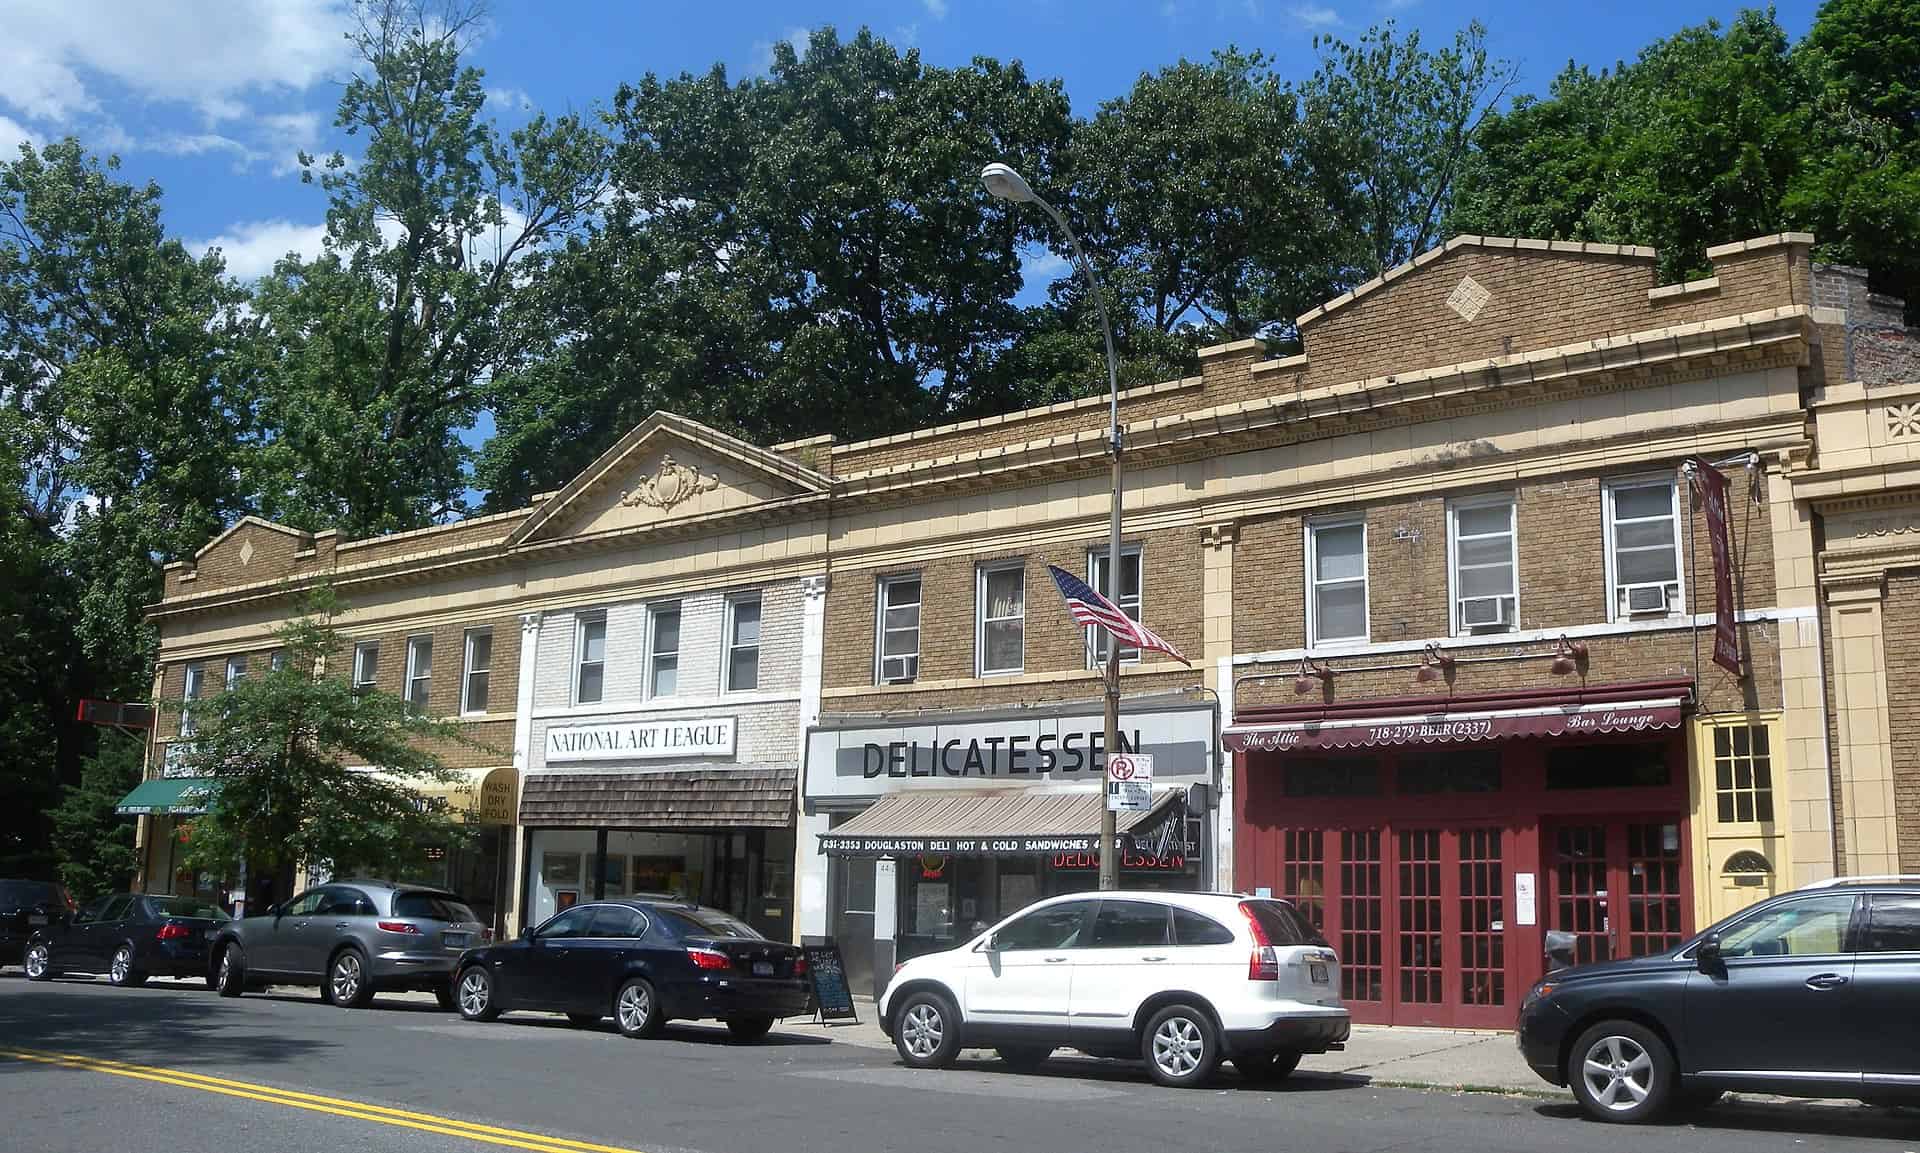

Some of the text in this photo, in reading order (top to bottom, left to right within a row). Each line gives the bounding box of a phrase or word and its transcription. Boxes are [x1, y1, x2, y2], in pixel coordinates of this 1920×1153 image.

[1567, 712, 1654, 728] Bar Lounge
[552, 725, 727, 752] NATIONAL ART LEAGUE
[1243, 731, 1299, 745] The Attic
[863, 730, 1141, 779] DELICATESSEN
[486, 783, 510, 794] WASH
[485, 808, 508, 819] FOLD
[864, 840, 924, 850] DOUGLASTON
[930, 841, 950, 850] DELI
[956, 841, 975, 850] HOT
[981, 841, 988, 850] &
[993, 840, 1018, 850] COLD
[1025, 839, 1088, 850] SANDWICHES
